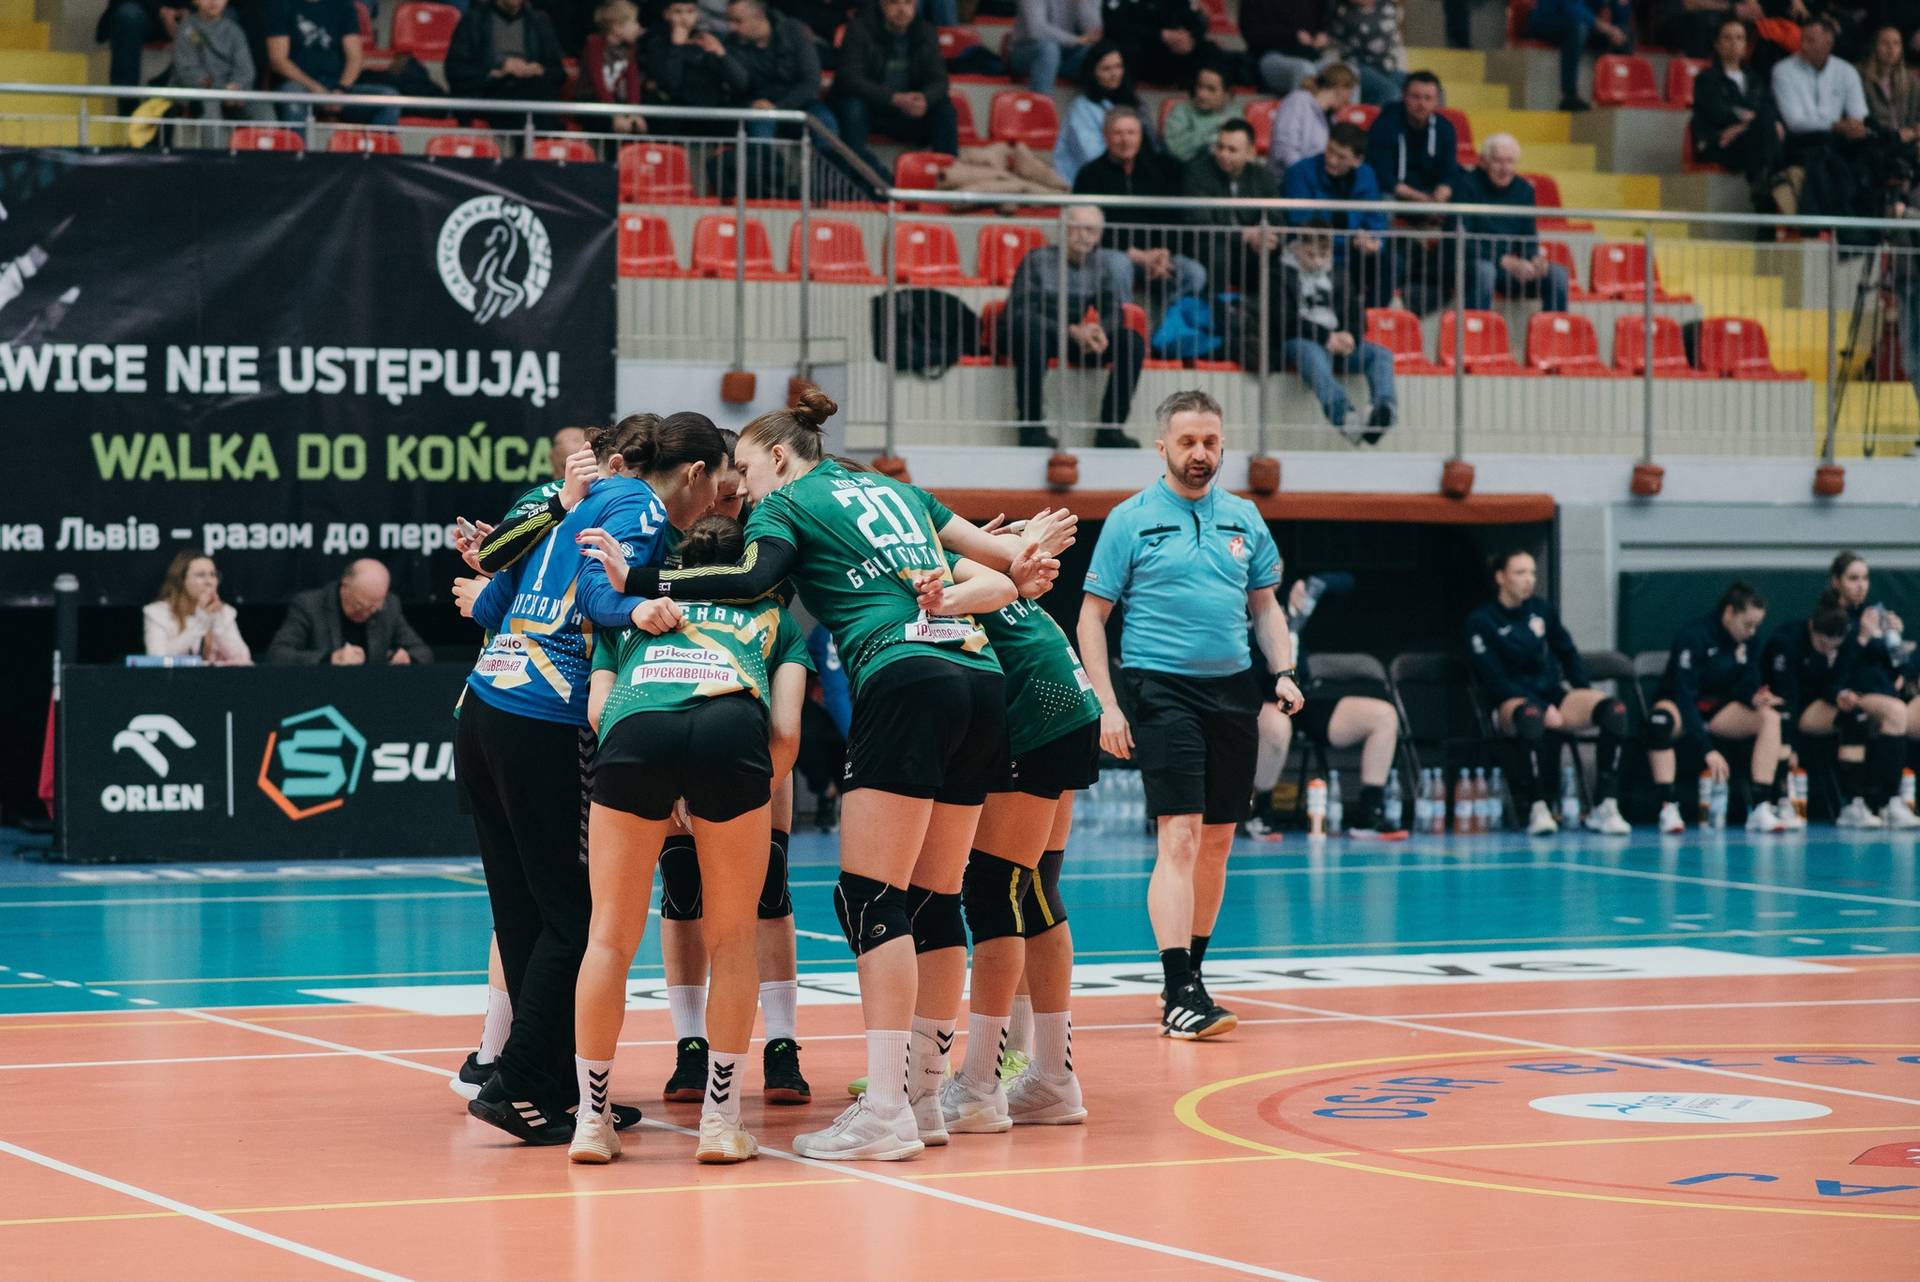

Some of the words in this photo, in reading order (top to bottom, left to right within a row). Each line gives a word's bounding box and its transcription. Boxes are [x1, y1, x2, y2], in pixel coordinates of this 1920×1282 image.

[0, 344, 148, 393] WICE
[166, 345, 261, 393] NIE
[278, 346, 560, 407] USTĘPUJĄ!
[90, 432, 280, 481] WALKA
[297, 433, 367, 481] DO
[56, 516, 160, 551] Львів
[203, 523, 313, 556] разом
[323, 523, 369, 555] до
[379, 523, 458, 556] пере
[831, 486, 927, 549] 20
[371, 741, 455, 782] SU
[101, 784, 204, 813] ORLEN
